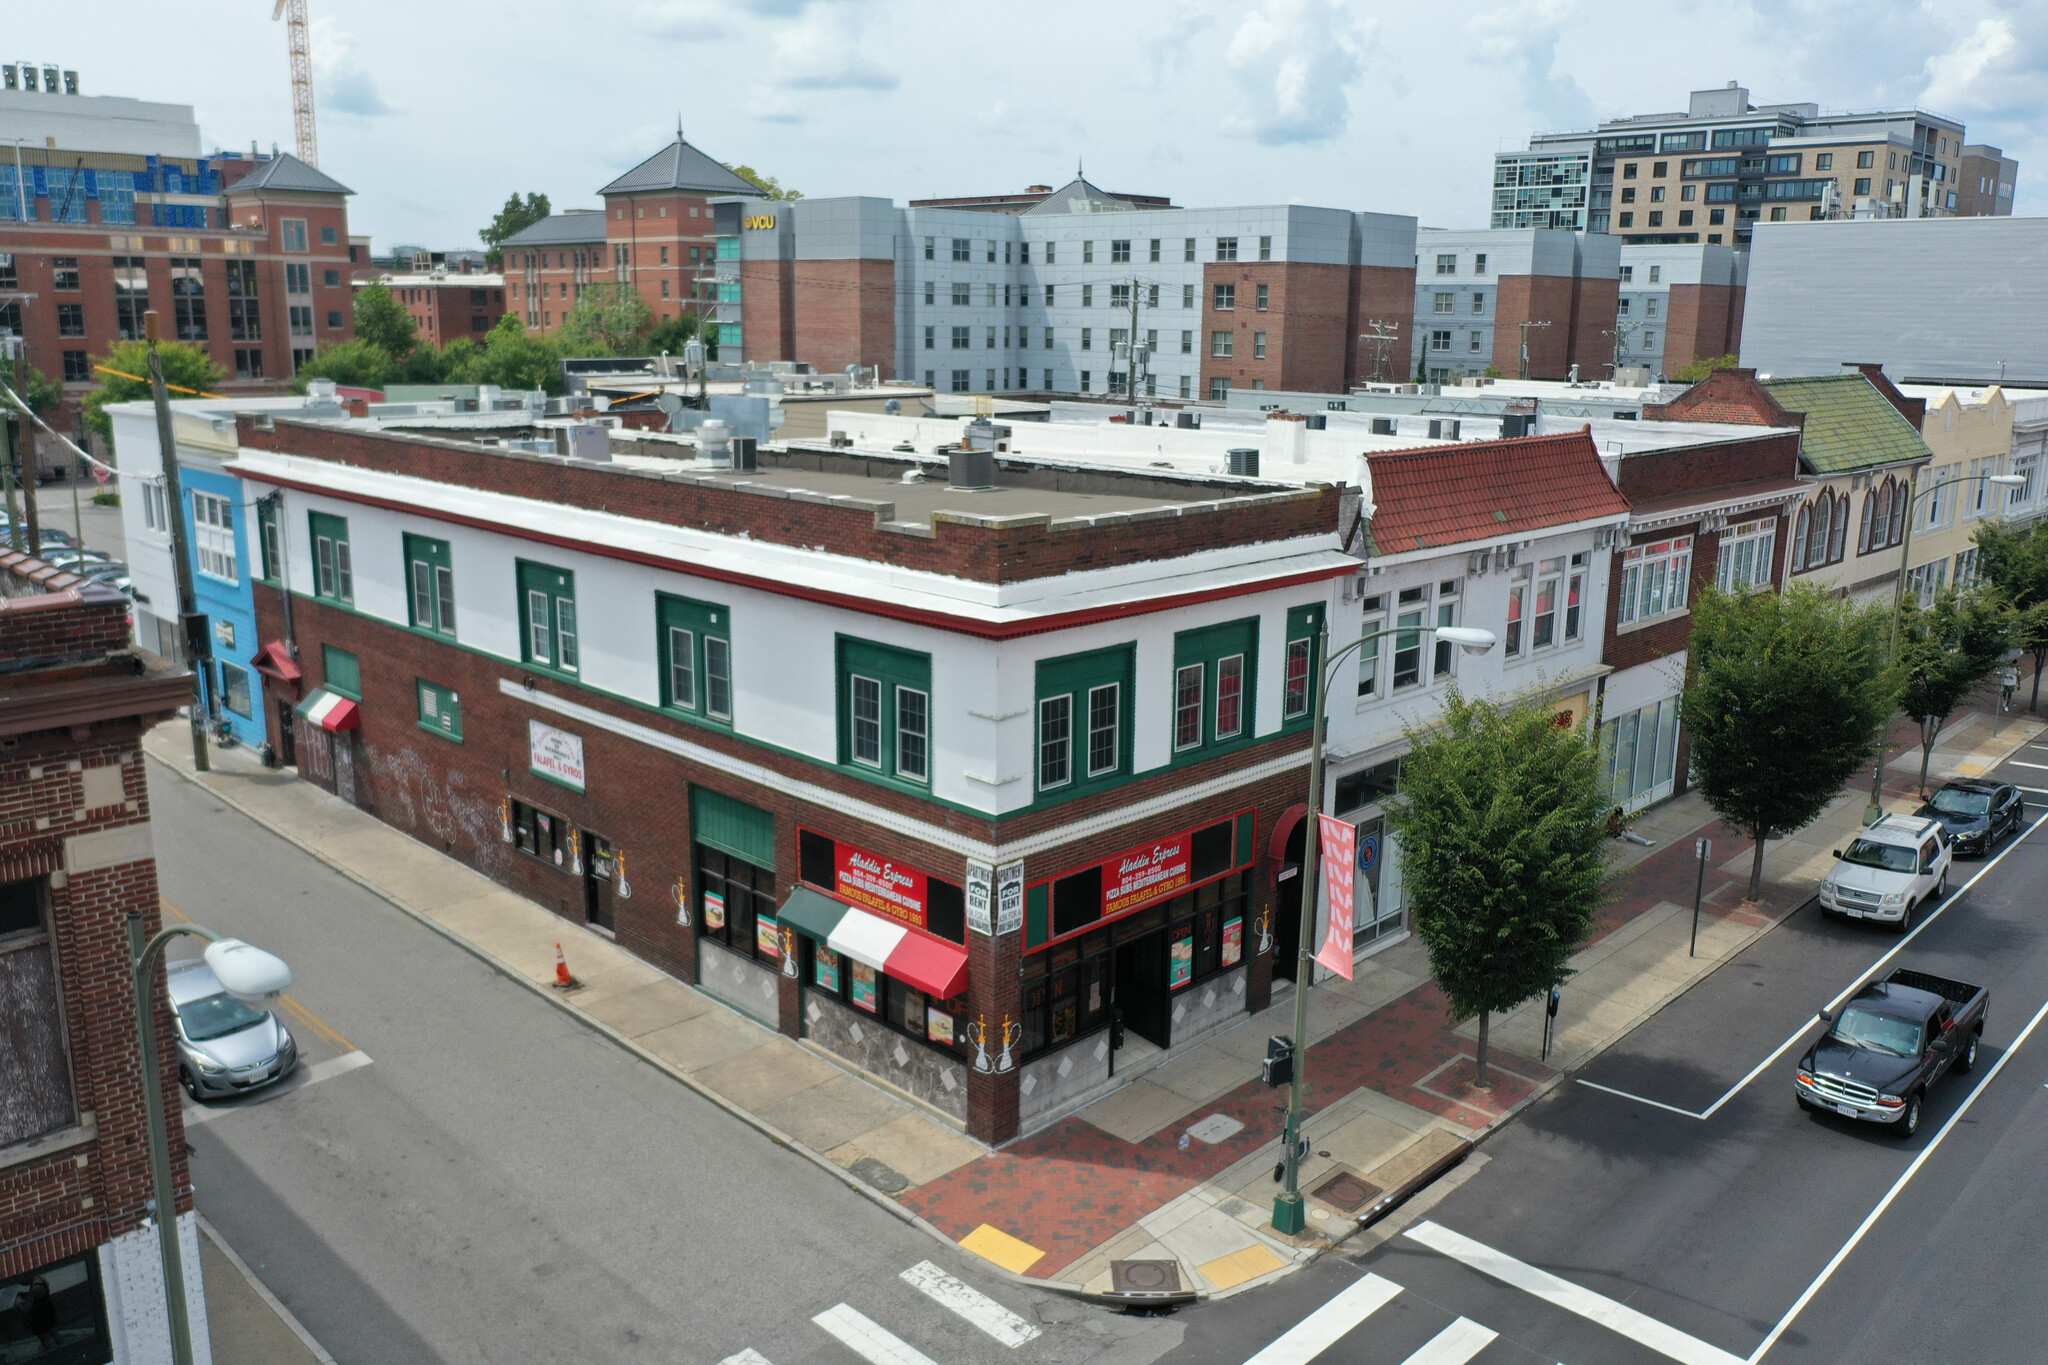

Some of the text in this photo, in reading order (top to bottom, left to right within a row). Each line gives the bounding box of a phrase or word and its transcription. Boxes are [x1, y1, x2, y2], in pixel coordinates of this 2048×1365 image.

[752, 215, 775, 229] VCU
[534, 752, 556, 769] FALAFEL
[563, 764, 582, 780] GYROS
[1118, 844, 1180, 878] Aladdin Express
[1170, 862, 1186, 876] CUISINE
[849, 852, 913, 888] Aladdin Express
[1122, 865, 1162, 884] 804-359-8500
[970, 885, 987, 896] FOR
[1002, 886, 1020, 897] FOR
[1106, 897, 1130, 914] FAMOUS
[1130, 888, 1152, 905] FALAFEL
[1154, 886, 1158, 895] &
[1158, 880, 1174, 893] GYRO
[840, 884, 863, 901] FAMOUS
[863, 893, 885, 911] FALAFEL
[886, 903, 891, 912] &
[892, 905, 908, 920] GYRO
[903, 896, 922, 912] CUISINE
[970, 894, 987, 910] RENT
[1002, 896, 1020, 911] RENT
